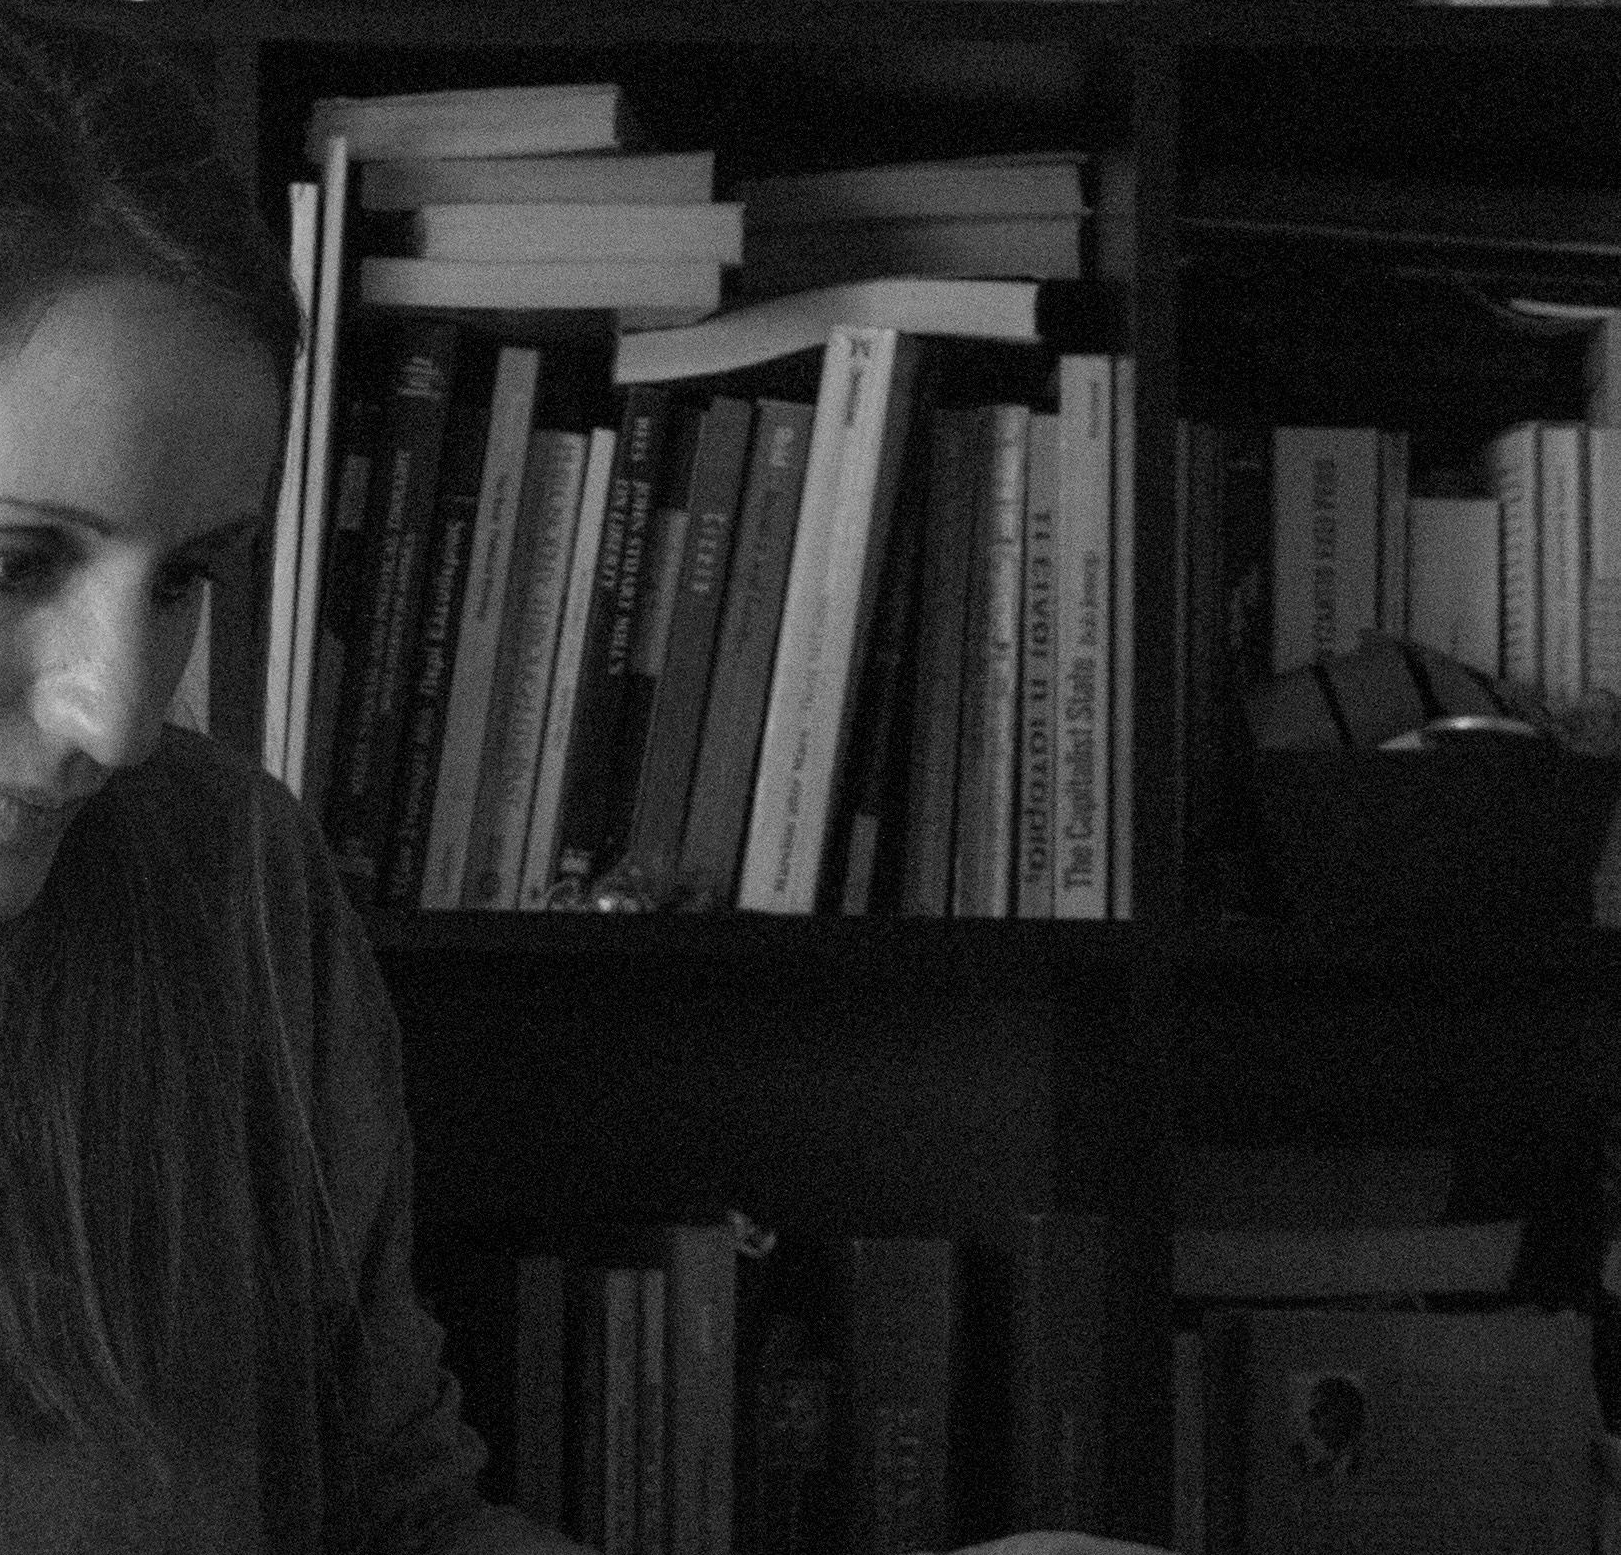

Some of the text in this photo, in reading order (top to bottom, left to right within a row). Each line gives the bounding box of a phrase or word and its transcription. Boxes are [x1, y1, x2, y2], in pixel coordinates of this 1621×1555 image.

[597, 477, 631, 591] ON LIBERTY
[623, 479, 652, 532] JOHN
[615, 535, 643, 611] STUART
[1066, 657, 1095, 723] State
[1064, 728, 1097, 841] Capitalist
[1063, 845, 1093, 890] The
